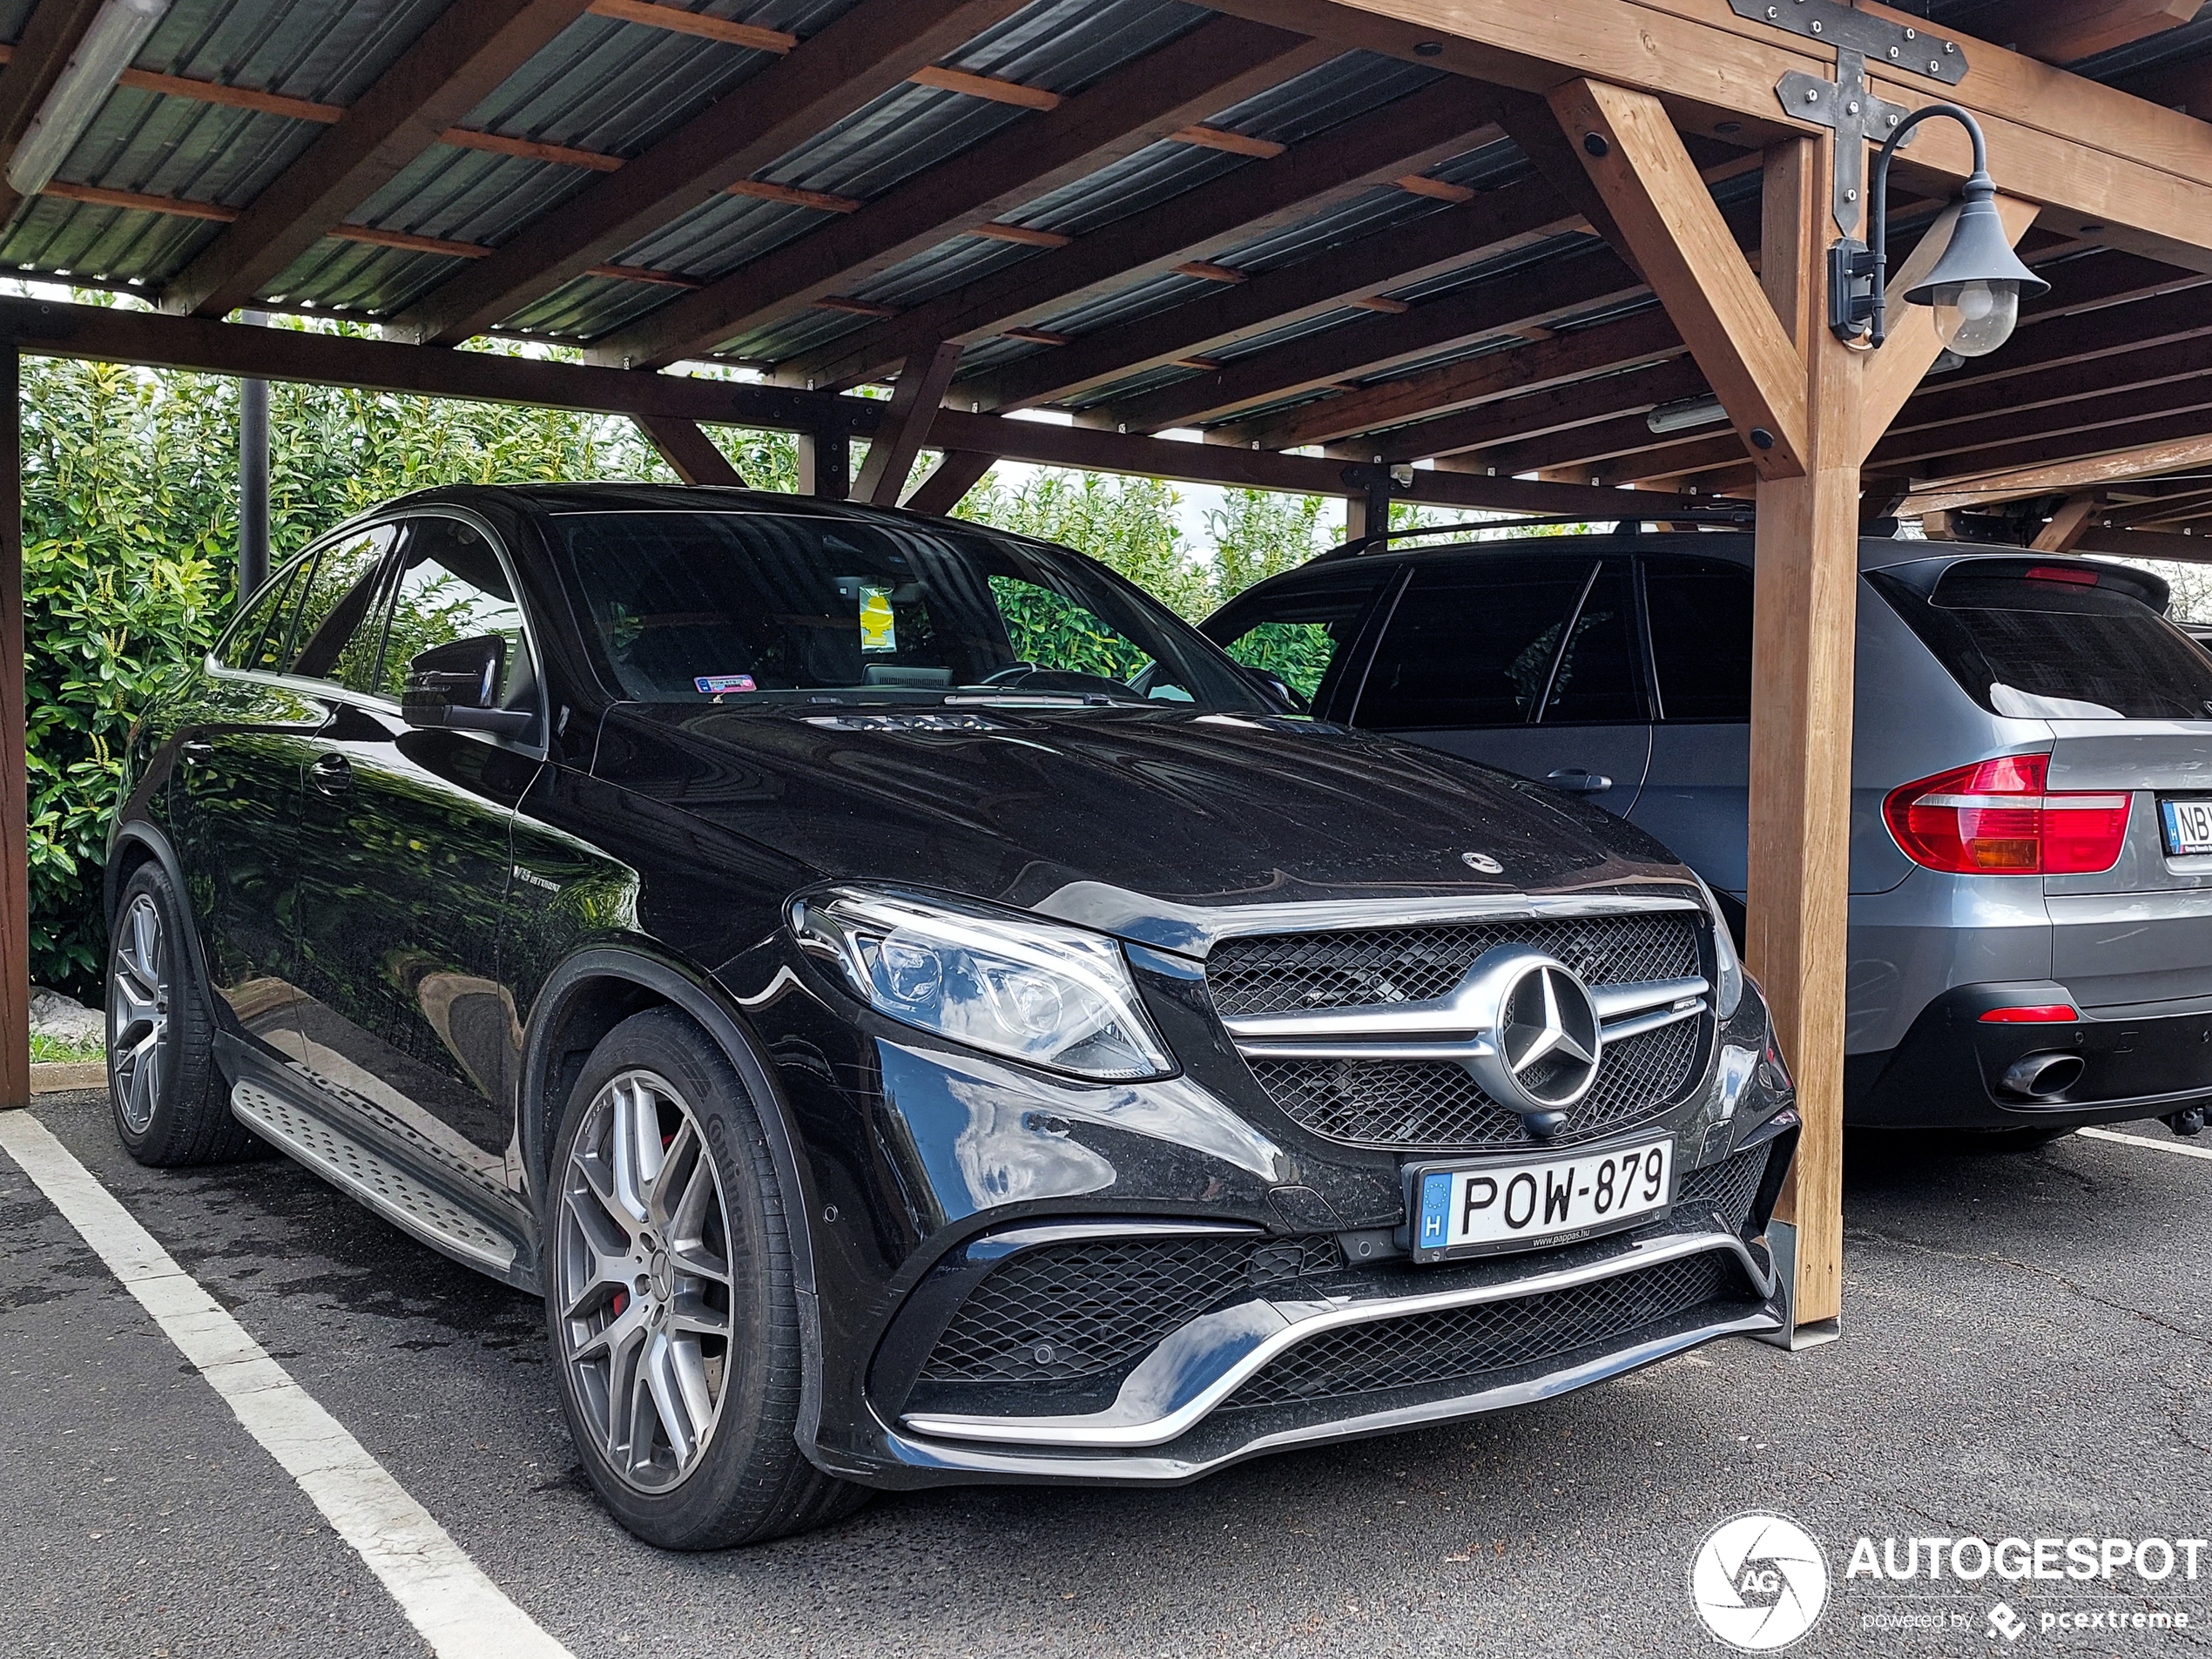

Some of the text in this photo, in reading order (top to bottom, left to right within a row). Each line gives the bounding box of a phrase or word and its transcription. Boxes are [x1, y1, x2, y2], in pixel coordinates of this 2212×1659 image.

[2170, 827, 2178, 841] H
[513, 865, 531, 882] V8
[1461, 1147, 1663, 1237] POW-879
[1424, 1216, 1441, 1238] H
[1533, 1229, 1590, 1247] www.pappas.hu
